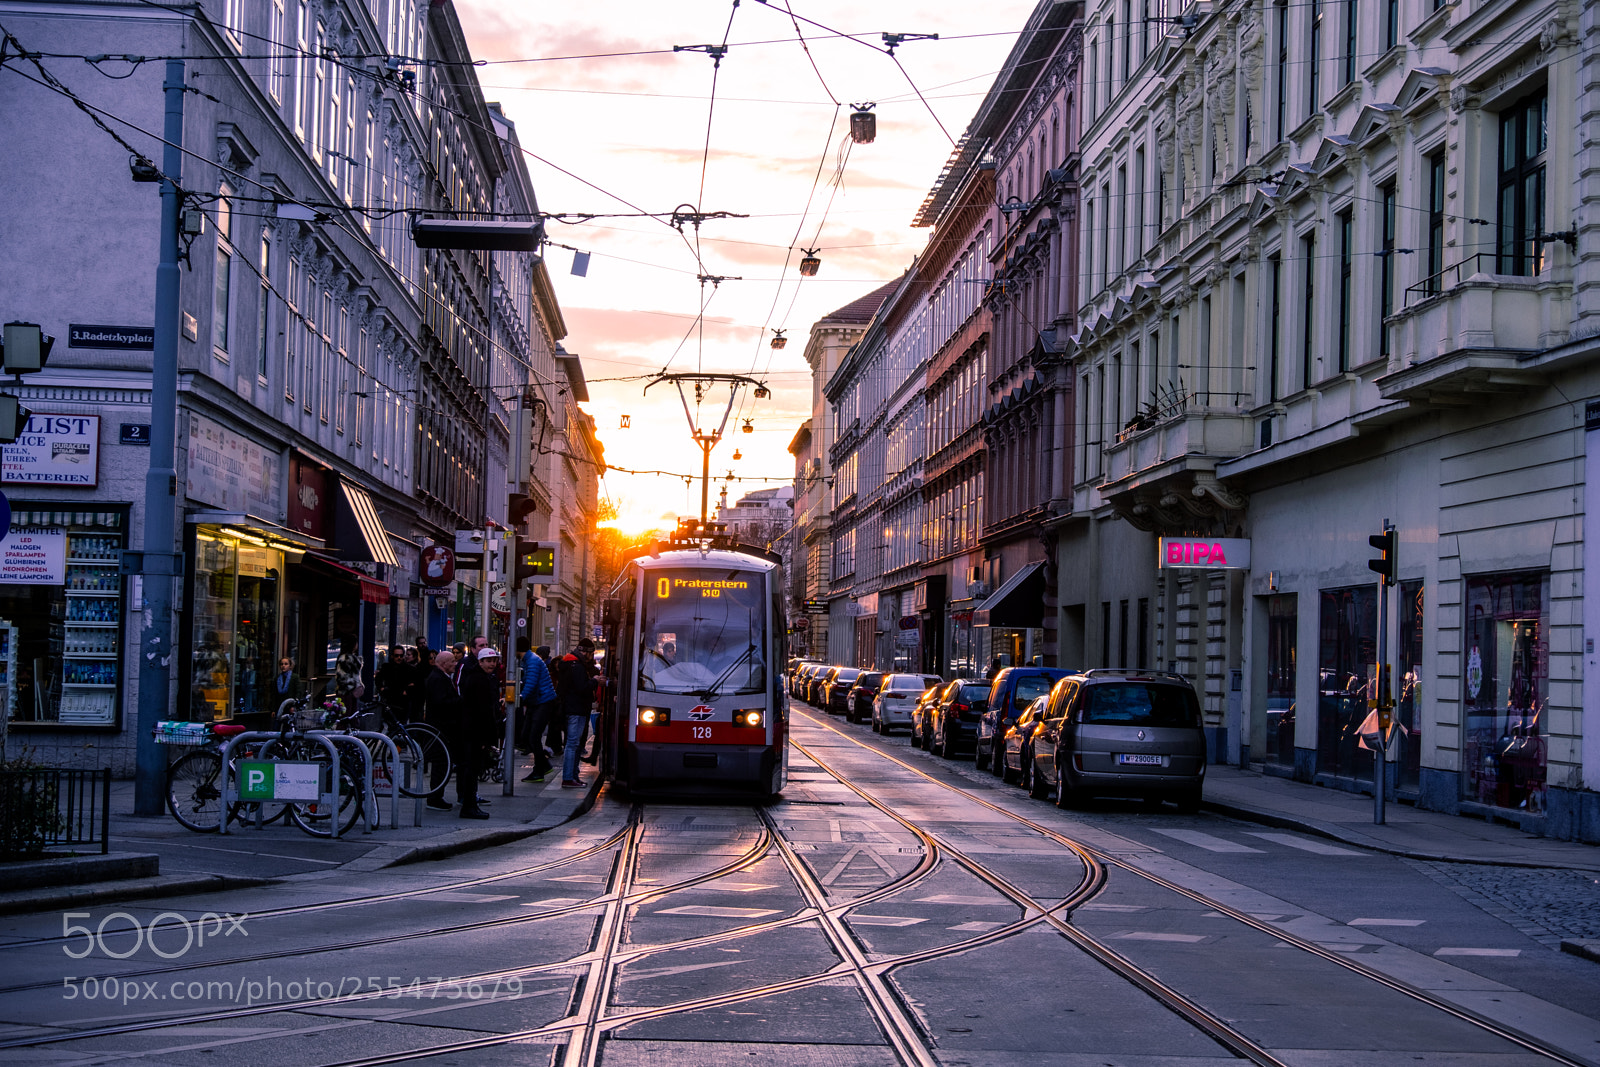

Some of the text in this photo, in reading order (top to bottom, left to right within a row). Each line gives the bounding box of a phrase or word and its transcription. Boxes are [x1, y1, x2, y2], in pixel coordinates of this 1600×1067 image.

[22, 416, 90, 435] LIST
[131, 426, 140, 437] 2
[53, 442, 90, 450] DURACELL
[6, 455, 37, 463] UHREN
[5, 472, 90, 482] BATTERIEN
[1167, 542, 1227, 565] BIPA
[19, 572, 54, 580] LÄMPCHEN
[674, 578, 748, 589] Praterstern
[692, 726, 712, 739] 128
[248, 769, 265, 792] P
